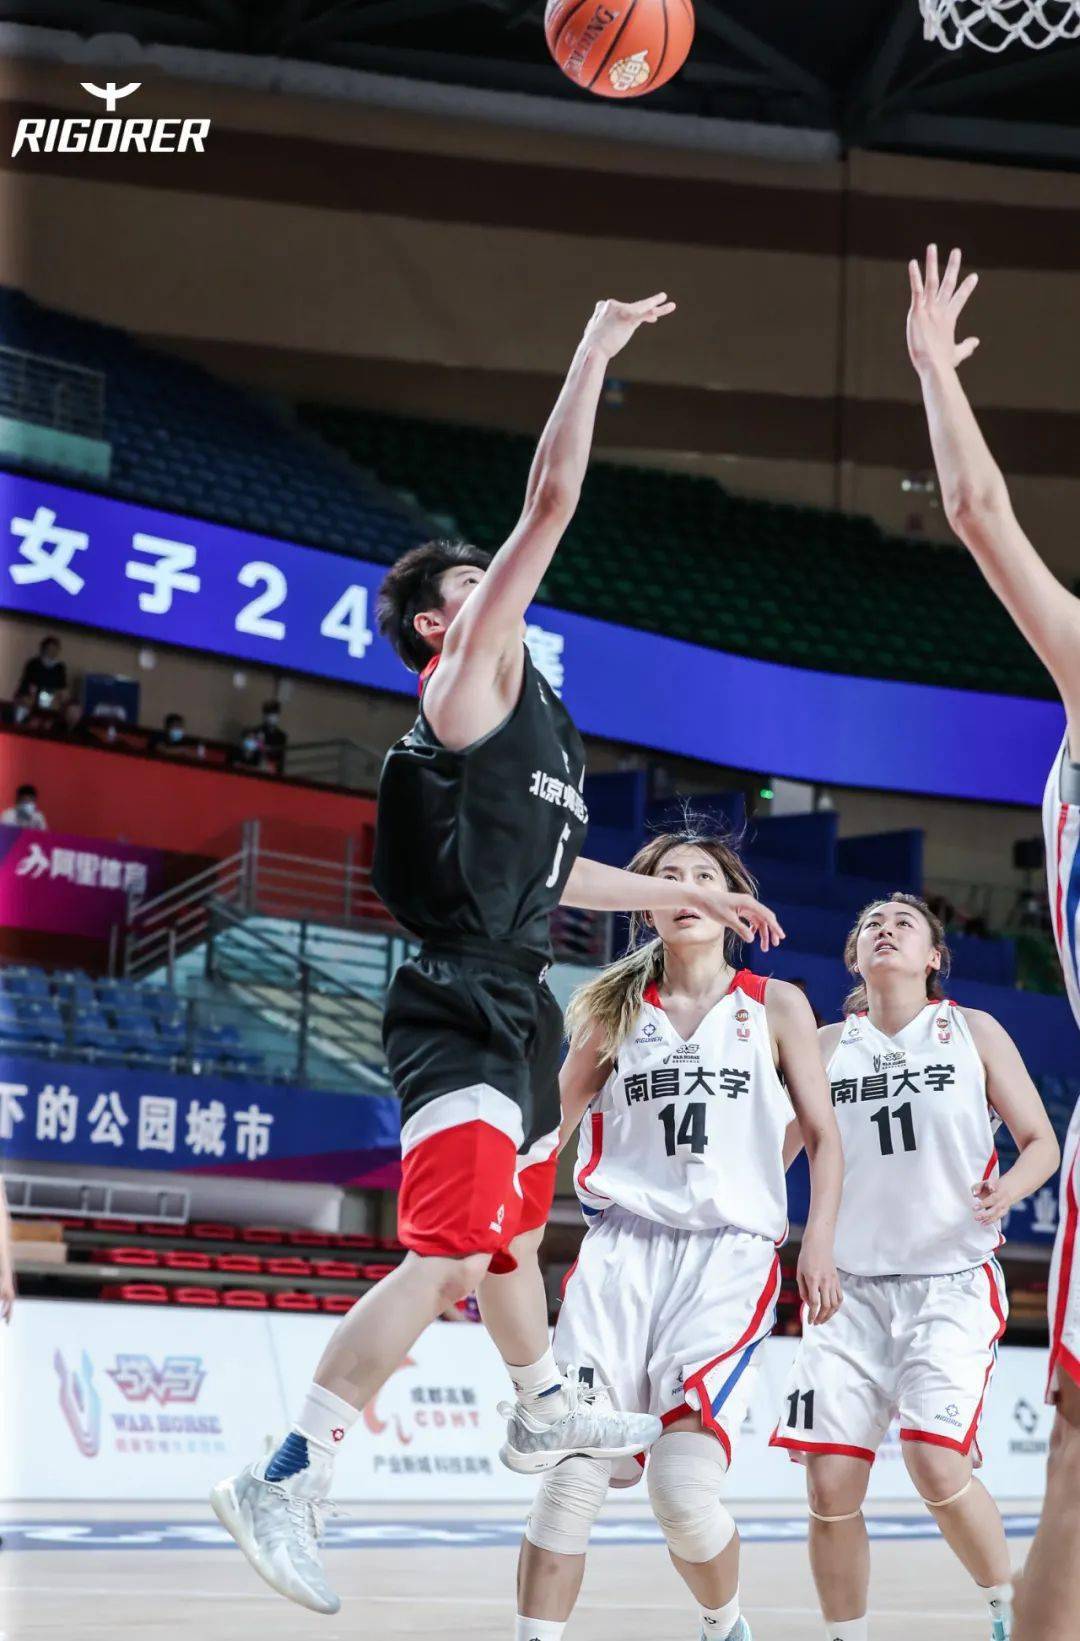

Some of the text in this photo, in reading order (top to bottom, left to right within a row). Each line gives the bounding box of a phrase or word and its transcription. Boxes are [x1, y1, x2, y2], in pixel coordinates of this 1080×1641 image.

[624, 1066, 750, 1106] 南昌大学
[831, 1064, 955, 1107] 南昌大学
[658, 1102, 708, 1156] 14
[870, 1102, 916, 1155] 11
[787, 1389, 814, 1430] 11
